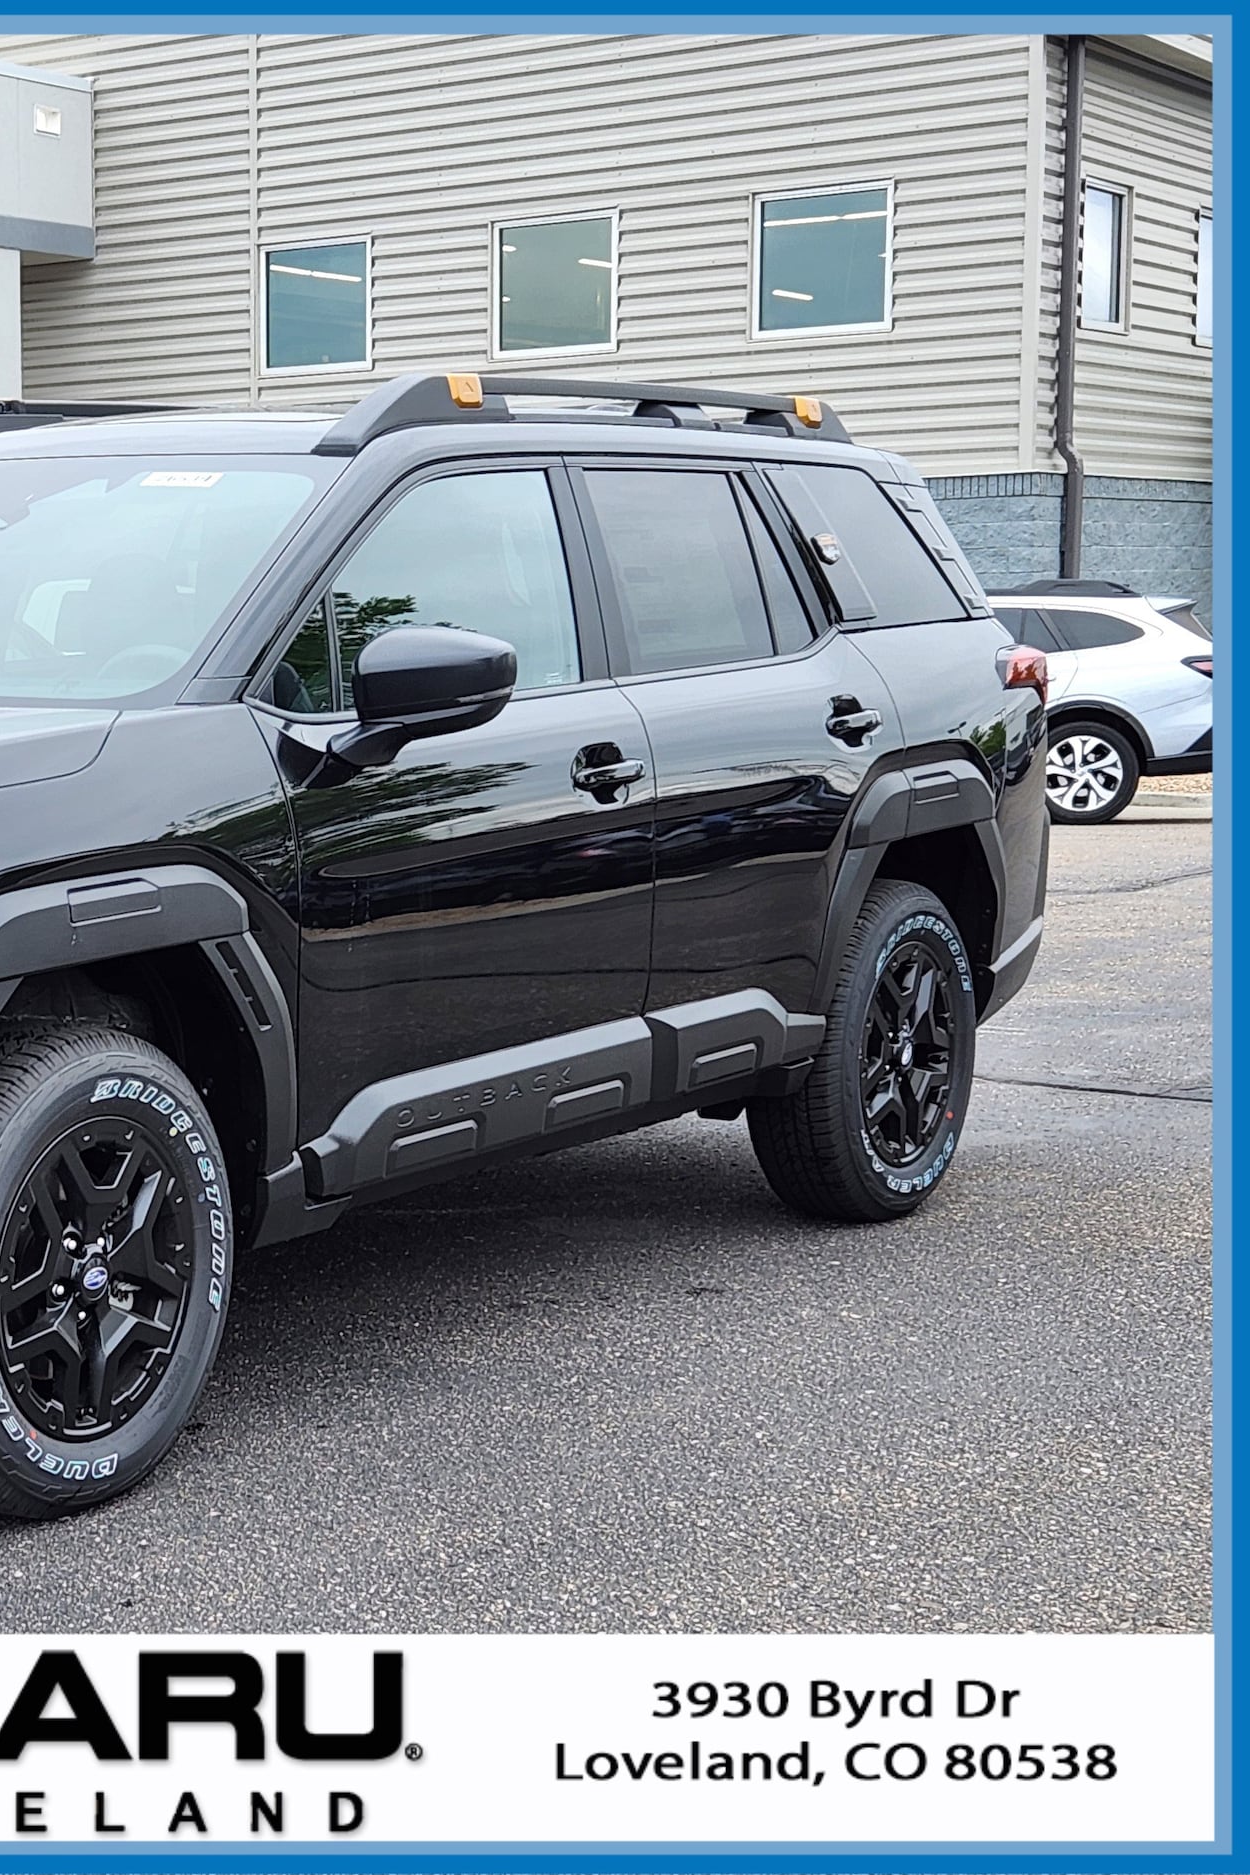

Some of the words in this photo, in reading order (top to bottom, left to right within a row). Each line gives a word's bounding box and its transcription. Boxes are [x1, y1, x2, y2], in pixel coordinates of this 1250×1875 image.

[875, 915, 972, 992] BRIDGESTONE
[397, 1066, 571, 1128] OUTBACK
[91, 1079, 226, 1312] BRIDGESTONE
